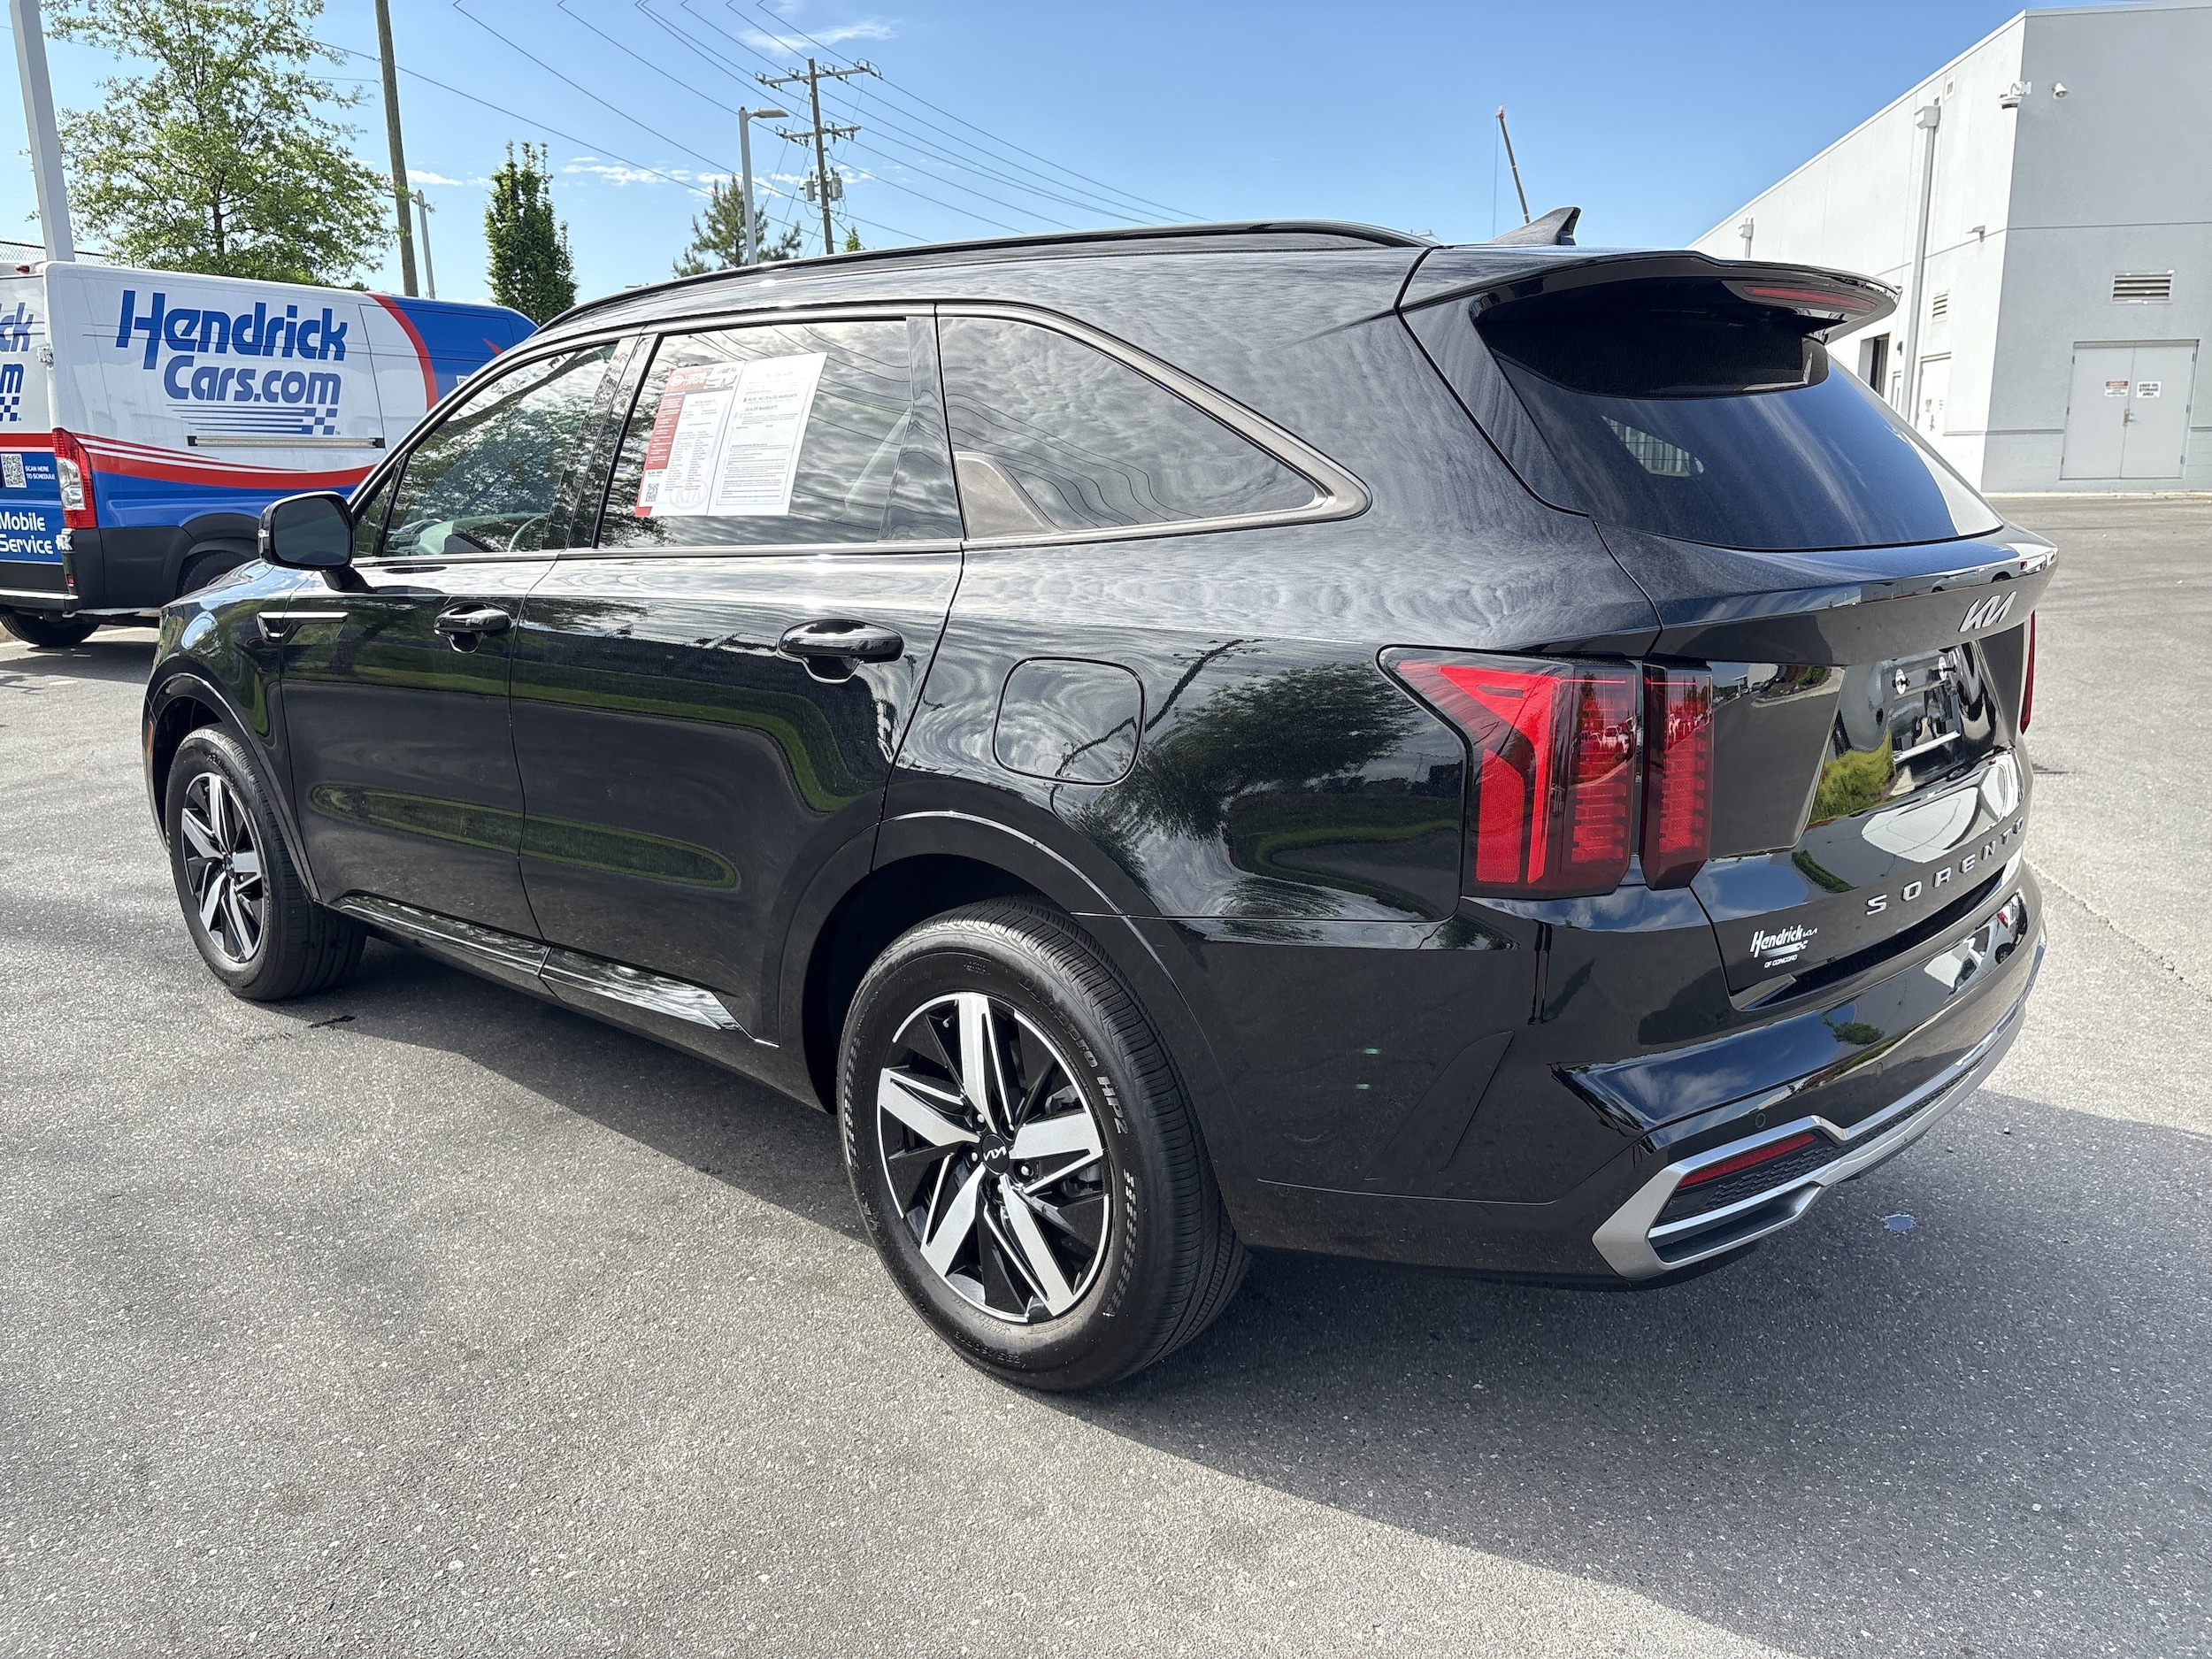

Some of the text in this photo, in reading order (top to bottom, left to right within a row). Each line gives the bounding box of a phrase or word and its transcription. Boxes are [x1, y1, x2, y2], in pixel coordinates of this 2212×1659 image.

[115, 289, 348, 370] Hendrick
[164, 354, 342, 405] Cars.com
[0, 511, 46, 532] Mobile
[0, 534, 54, 555] Service
[1864, 816, 2024, 917] SORENTO
[1749, 924, 1803, 958] Hendrick
[1763, 954, 1799, 969] OF CONCORD
[1096, 1075, 1129, 1135] HP2
